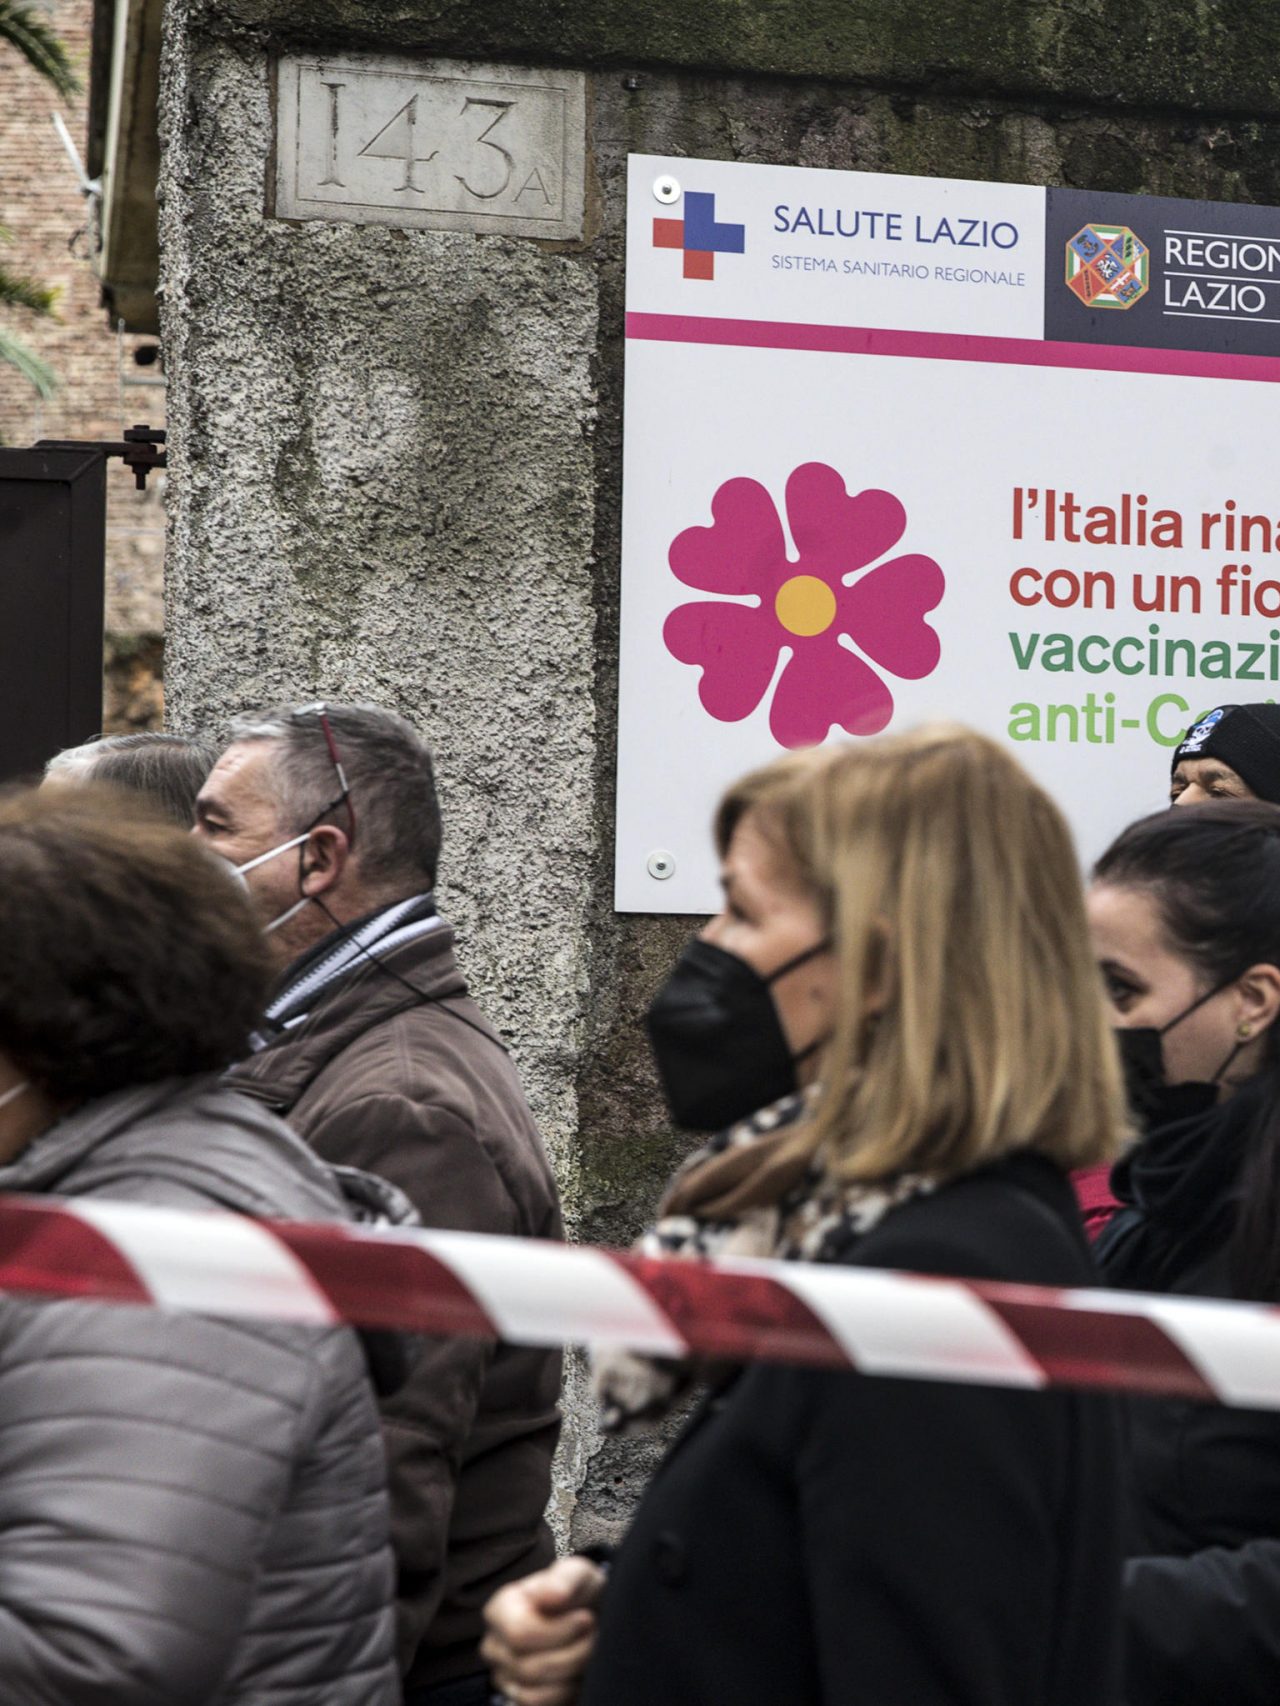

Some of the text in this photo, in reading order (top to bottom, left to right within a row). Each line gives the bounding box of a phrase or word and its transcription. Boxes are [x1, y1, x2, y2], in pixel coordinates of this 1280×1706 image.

[773, 204, 1019, 250] SALUTE LAZIO
[771, 254, 1026, 287] SISTEMA SANITARIO REGIONALE
[1163, 278, 1266, 313] LAZIO
[1009, 567, 1116, 609] con
[1132, 574, 1201, 614] un
